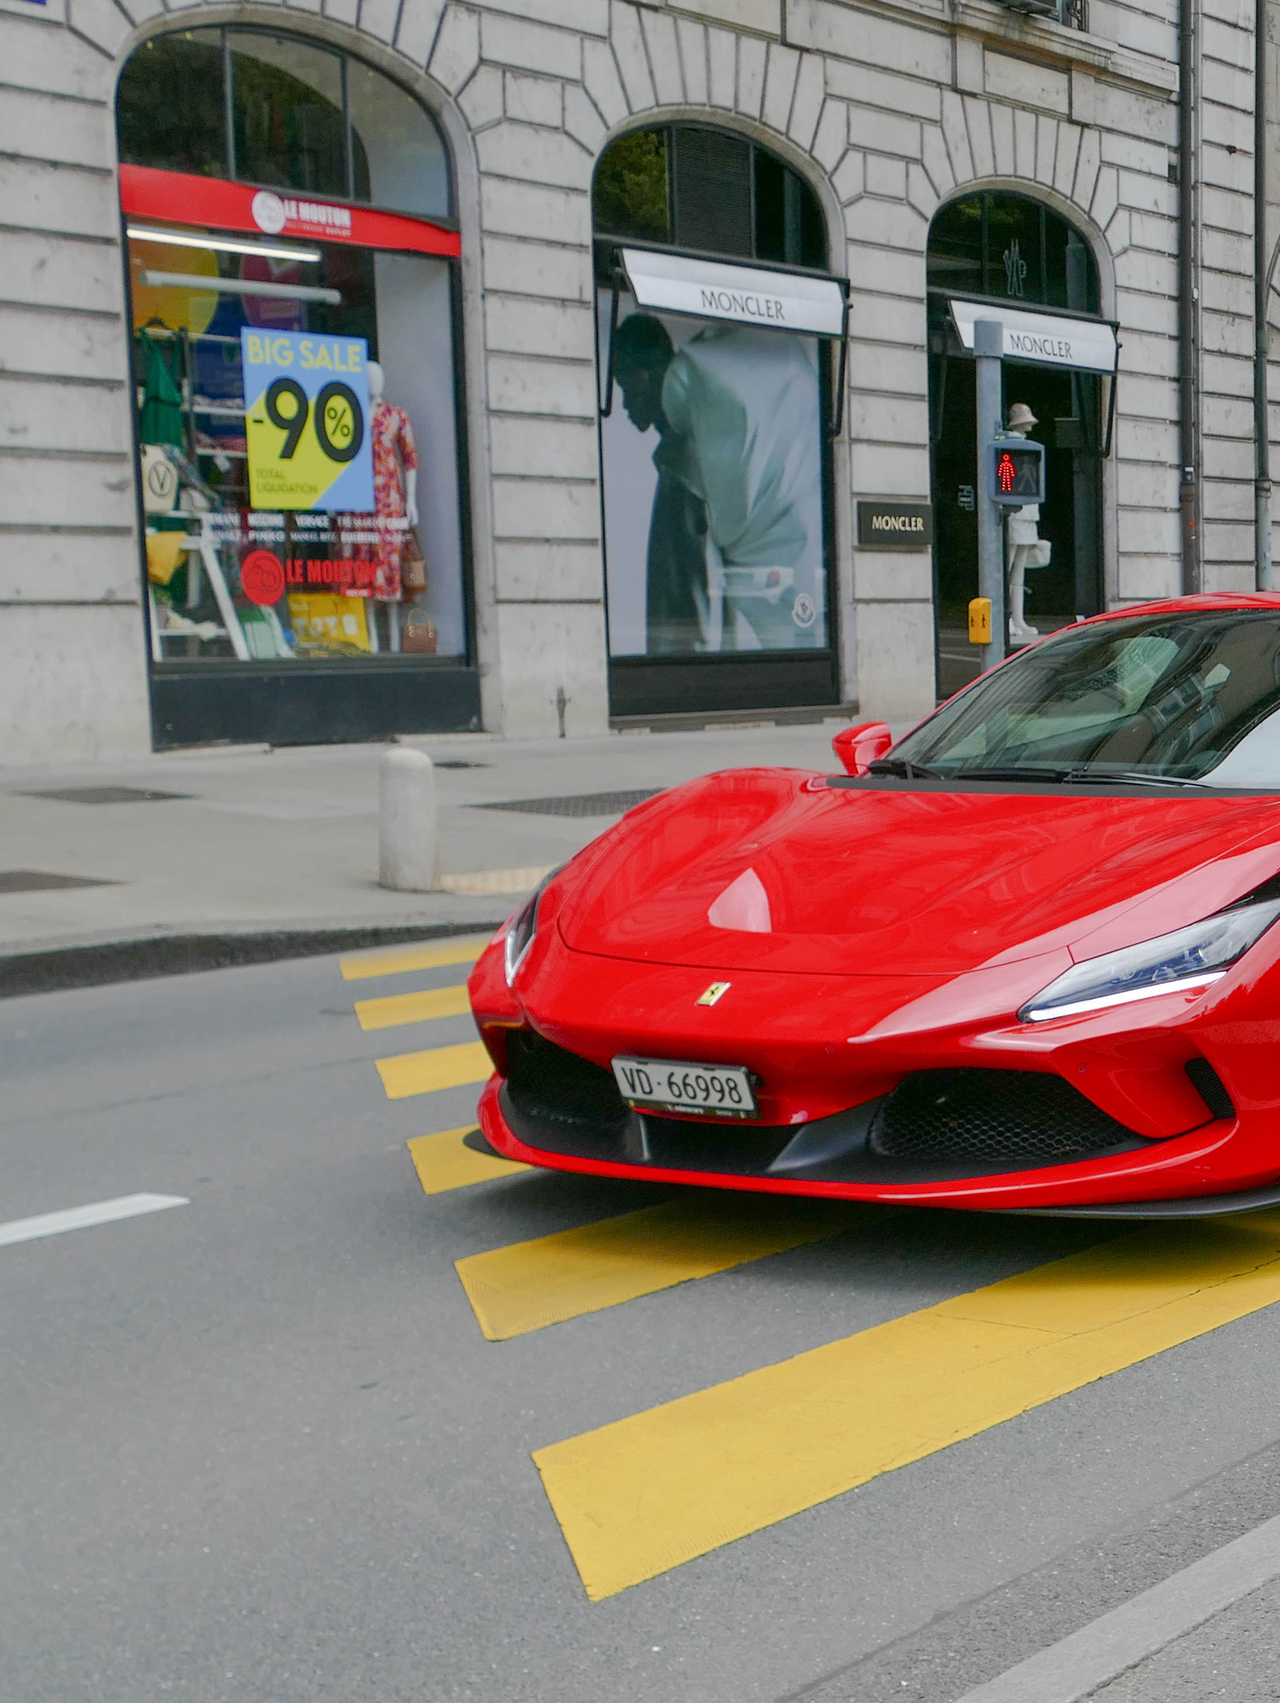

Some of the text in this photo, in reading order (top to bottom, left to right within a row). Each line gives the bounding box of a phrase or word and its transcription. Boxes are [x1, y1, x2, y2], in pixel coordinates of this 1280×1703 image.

[284, 199, 297, 219] LE
[299, 201, 351, 228] MOUTON
[700, 289, 786, 320] MONCLER
[247, 334, 362, 373] BIG SALE
[1009, 334, 1073, 359] MONCLER
[255, 468, 286, 479] TOTAL
[256, 482, 318, 494] LIQUIDATION
[871, 515, 924, 532] MONCLER
[286, 559, 378, 584] LE MOUTON
[621, 1067, 743, 1104] VD 66998
